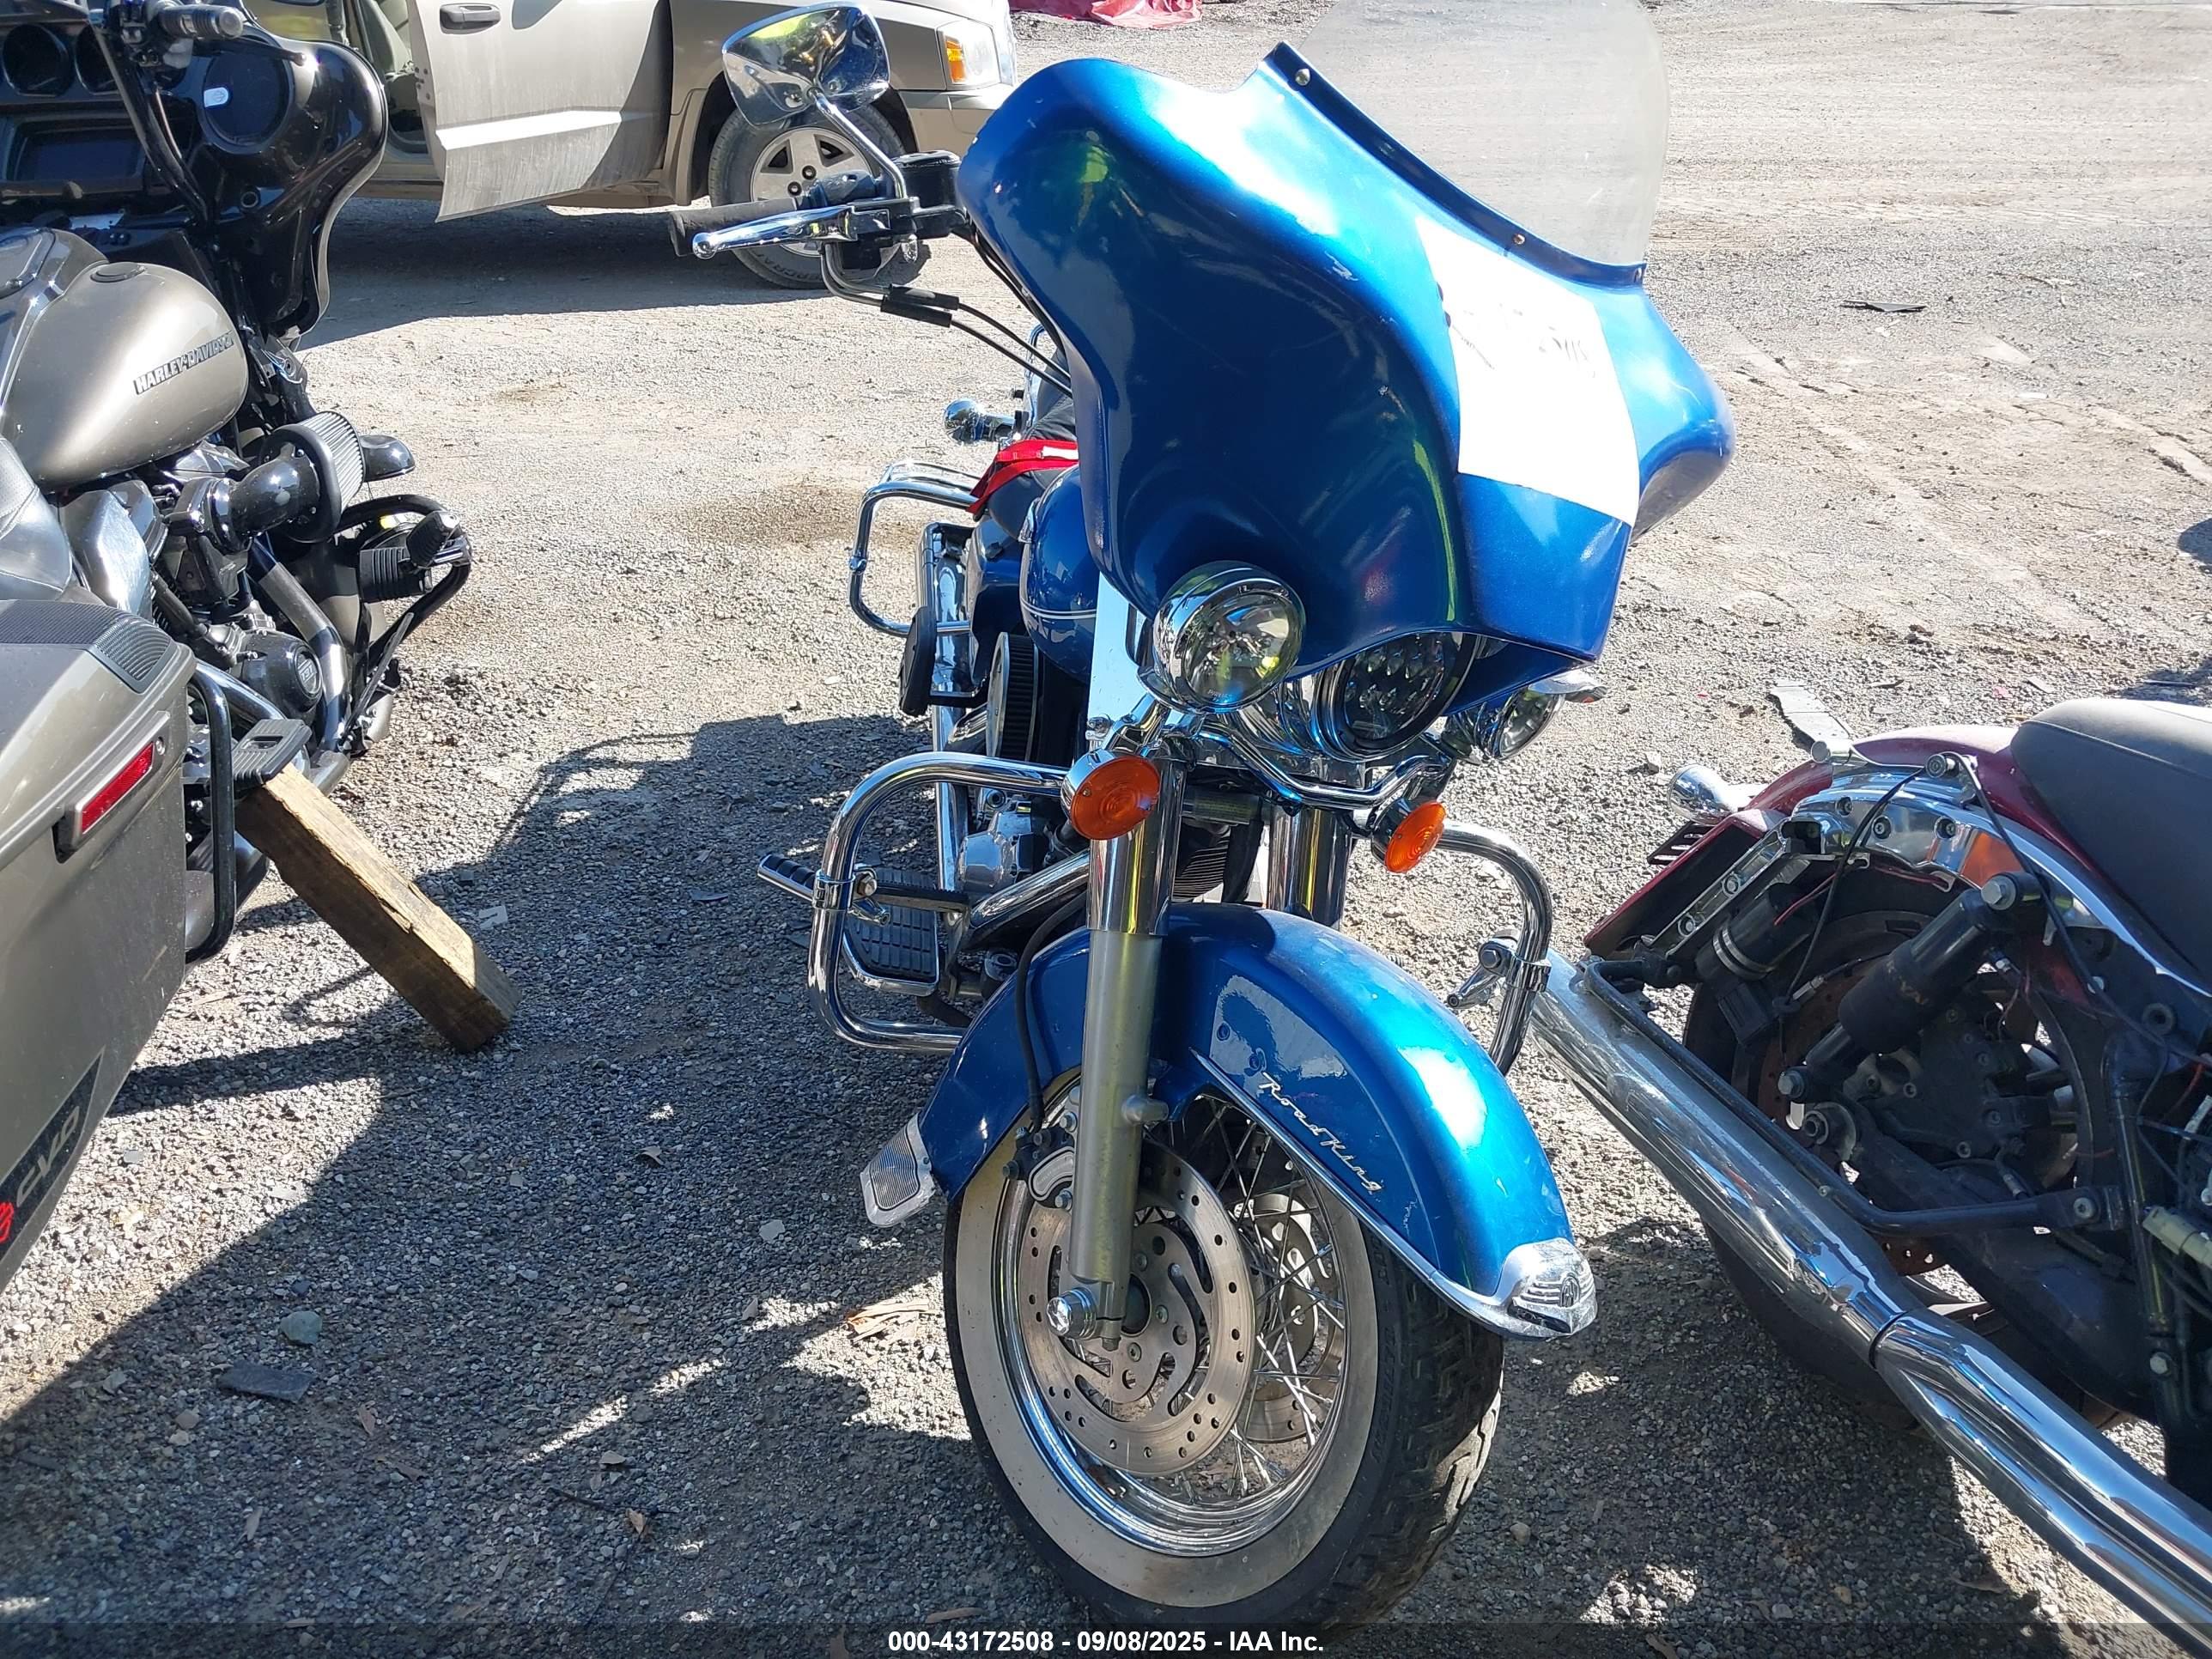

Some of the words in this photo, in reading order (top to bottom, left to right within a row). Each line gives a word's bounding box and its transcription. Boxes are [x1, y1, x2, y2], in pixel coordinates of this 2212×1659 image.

[16, 1105, 81, 1208] CVO
[1258, 1072, 1324, 1137] Road
[1319, 1127, 1383, 1192] King
